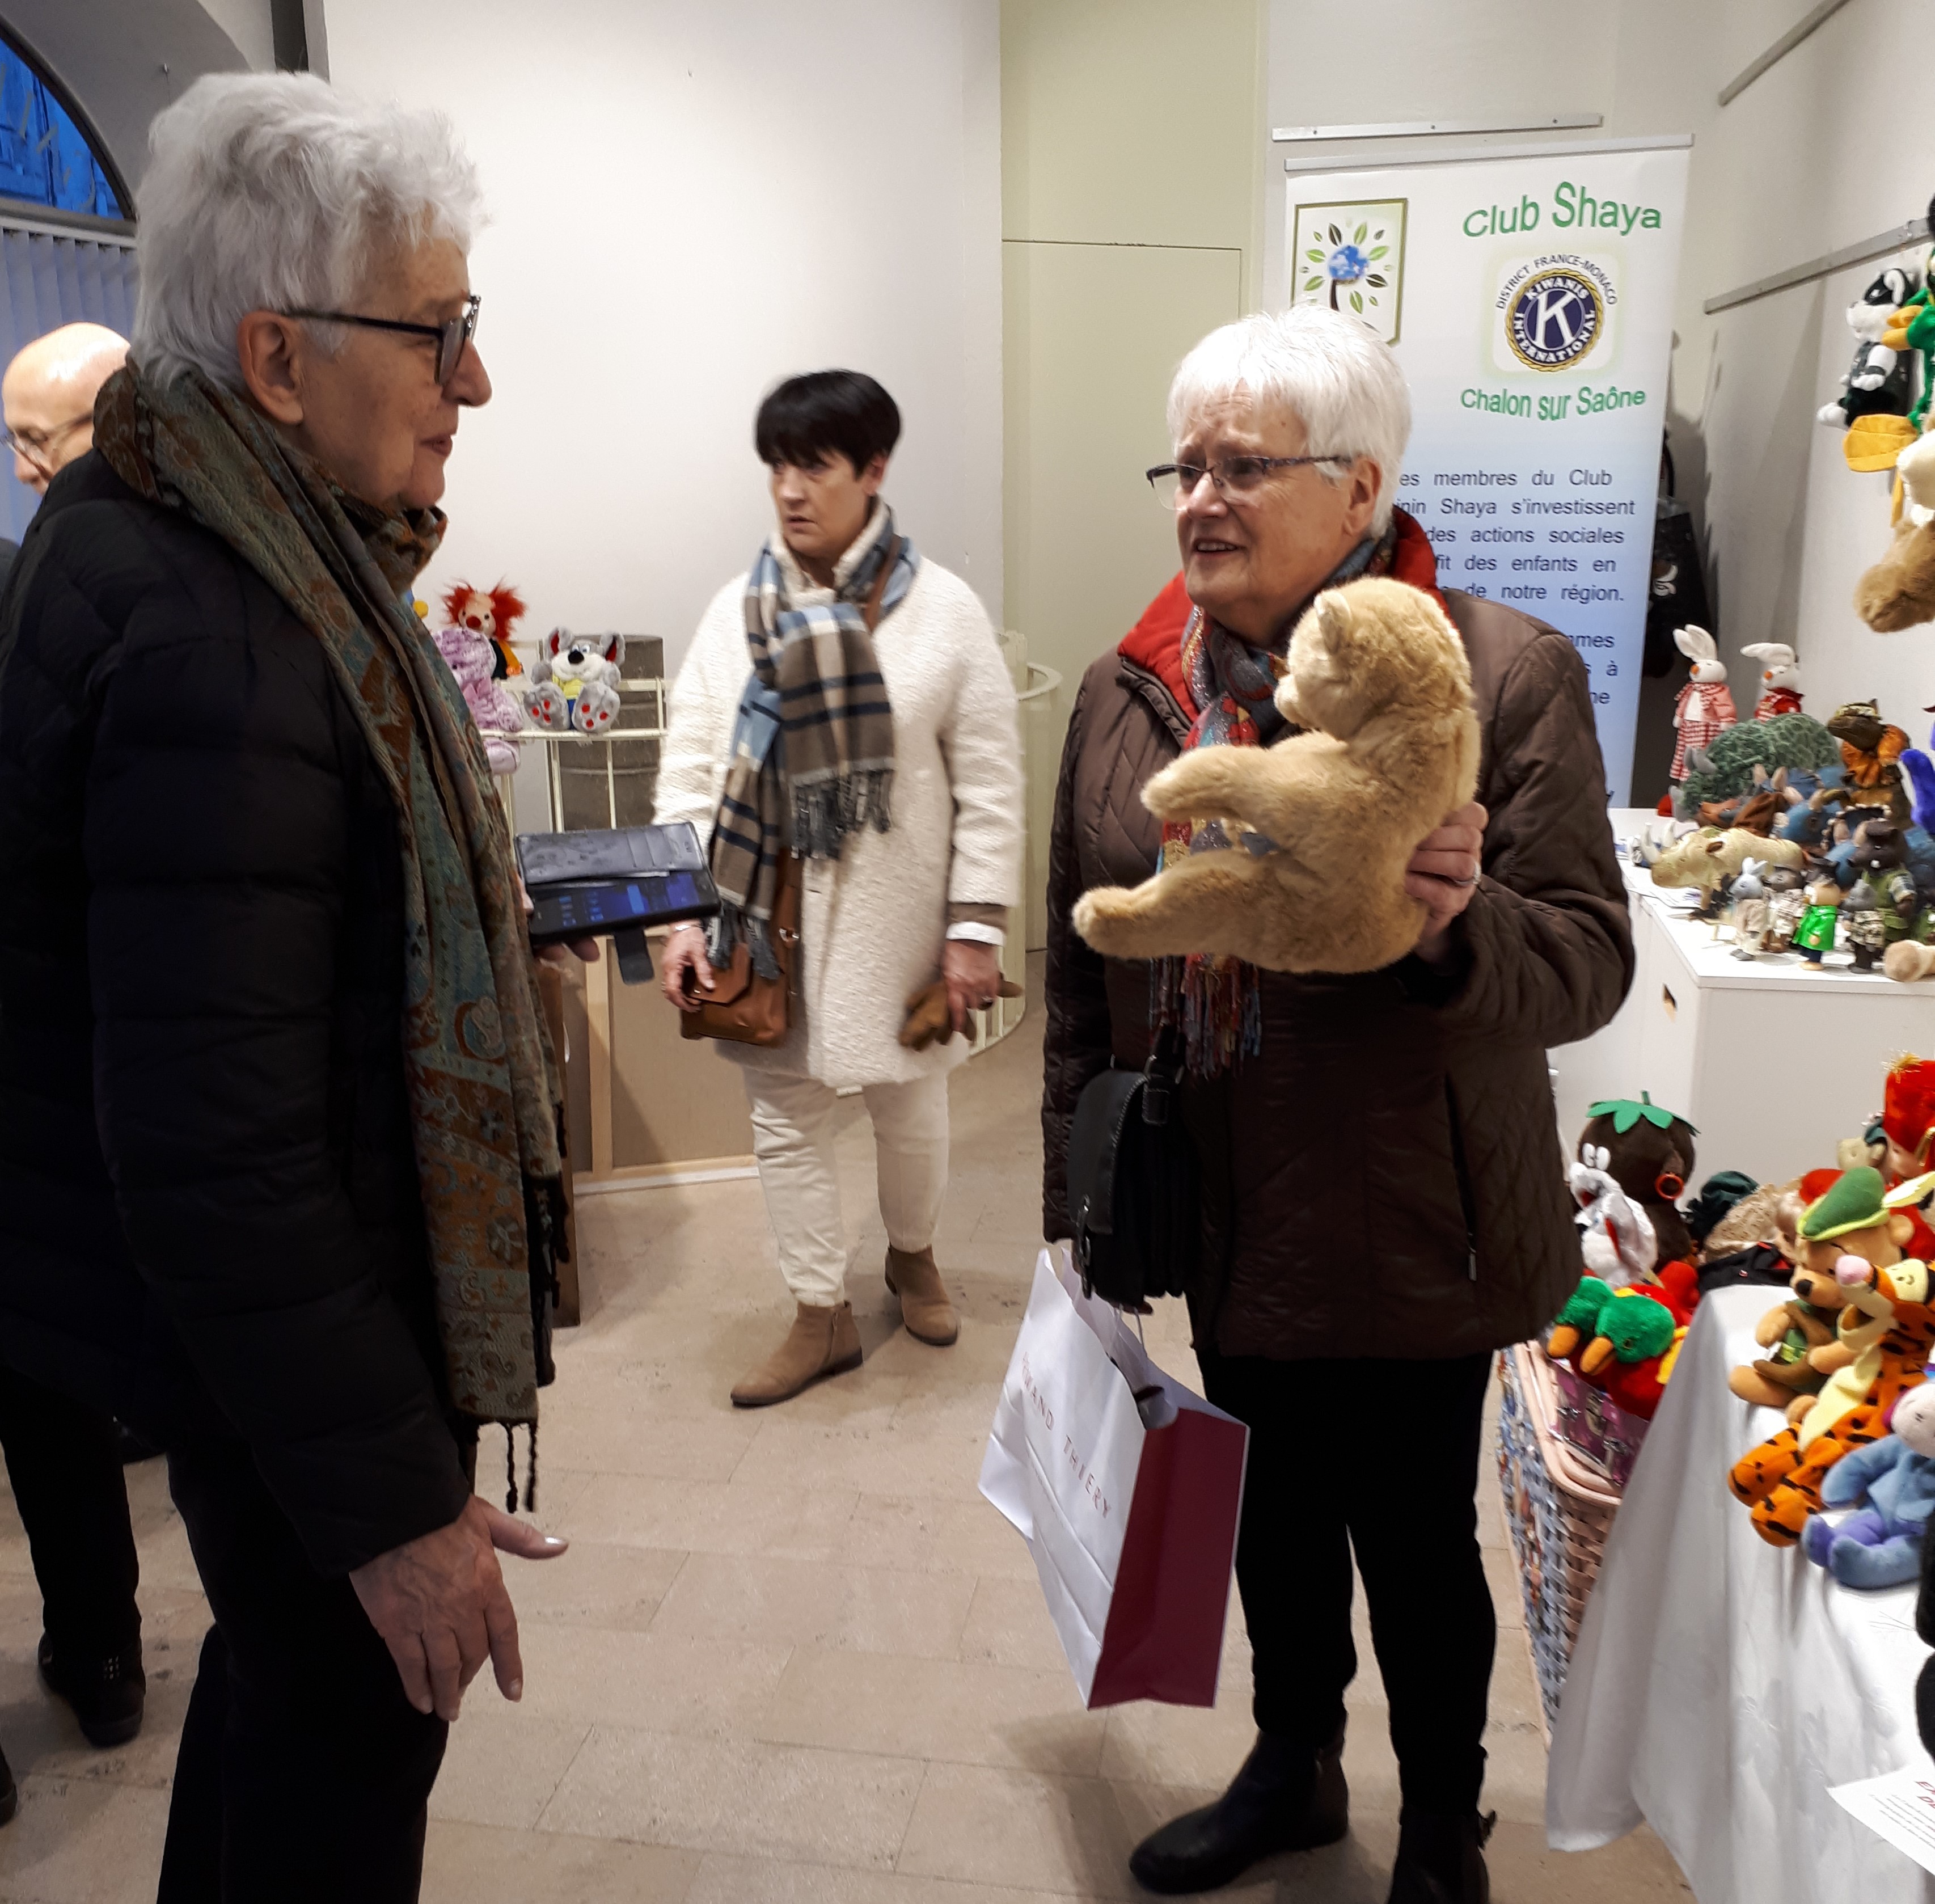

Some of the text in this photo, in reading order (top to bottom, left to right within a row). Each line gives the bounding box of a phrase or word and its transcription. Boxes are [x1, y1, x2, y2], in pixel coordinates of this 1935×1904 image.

[1463, 181, 1662, 237] Club Shaya
[1494, 254, 1618, 310] DISTRICT FRANCE-MONACO
[1524, 277, 1590, 301] KIWANIS
[1531, 289, 1577, 350] K
[1512, 309, 1596, 363] INTERNATIONAL
[1460, 386, 1646, 421] Chalon sur Saône
[1399, 469, 1613, 486] es membres du Club
[1439, 498, 1497, 518] Shaya
[1510, 499, 1636, 515] s'investissent
[1426, 526, 1625, 544] des actions sociales
[1435, 554, 1616, 572] fit des enfants en
[1464, 582, 1624, 605] de notre région.
[1606, 660, 1618, 677] à
[1063, 1434, 1112, 1519] THIERY
